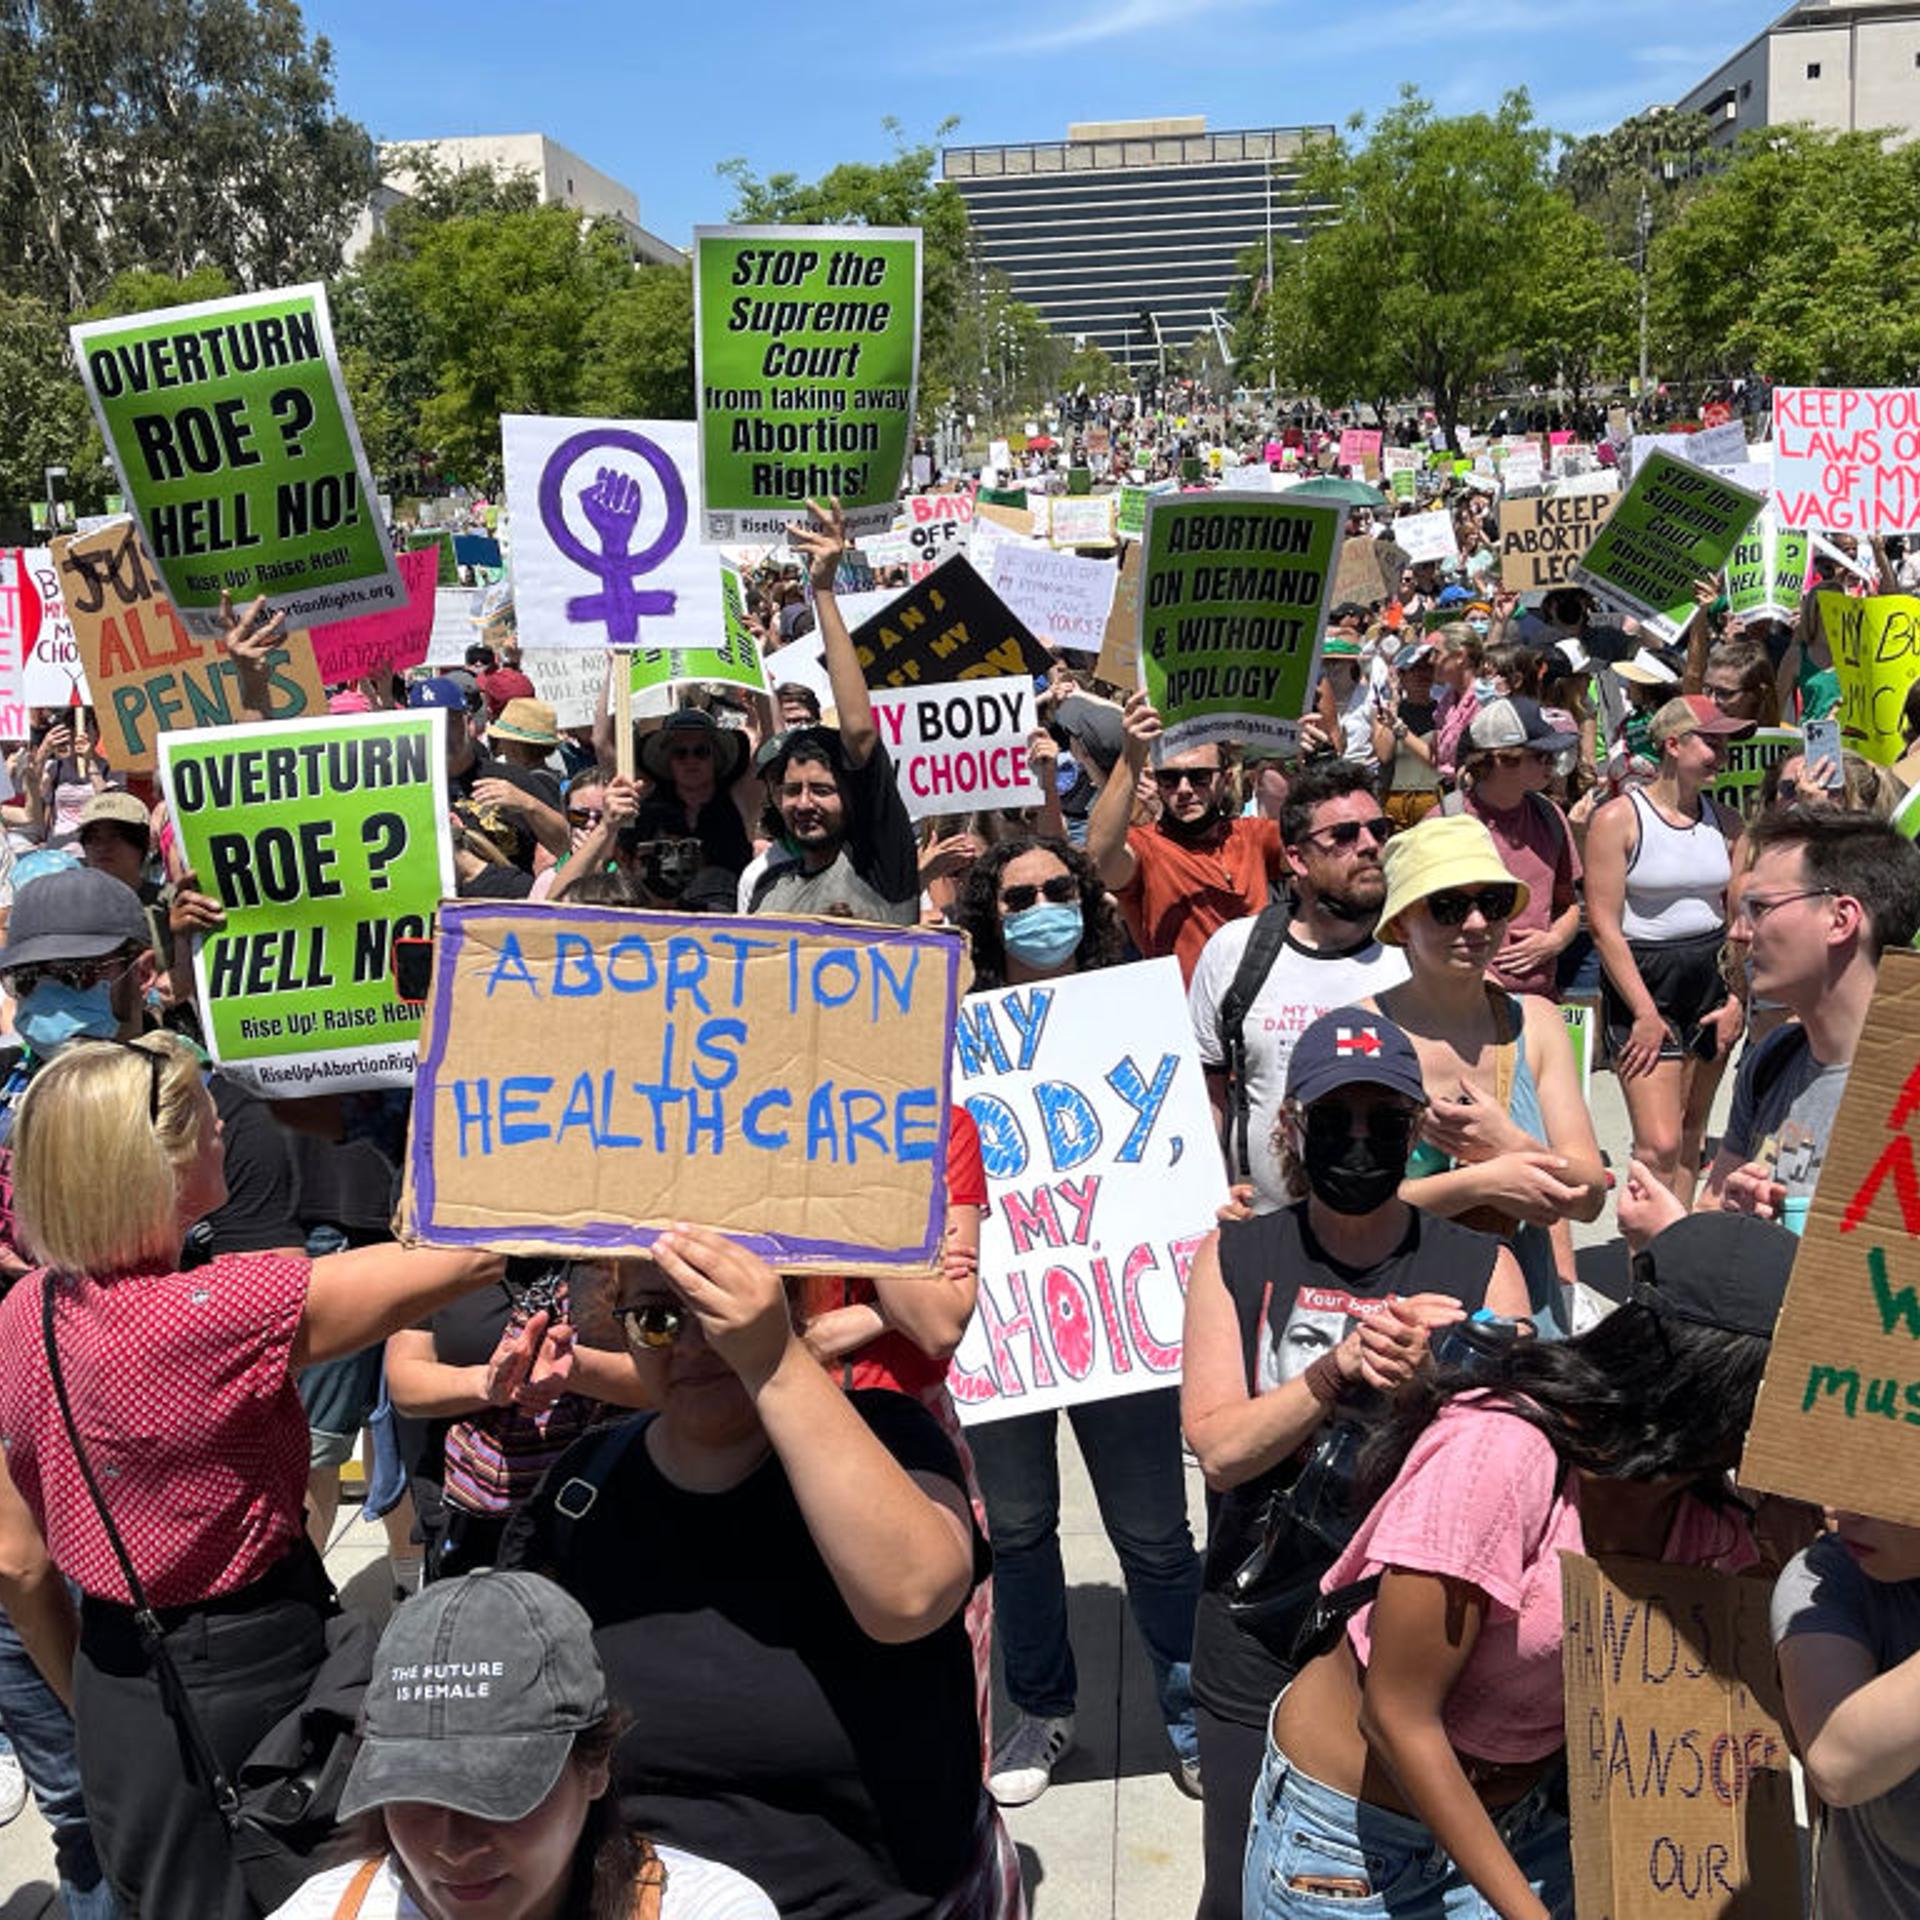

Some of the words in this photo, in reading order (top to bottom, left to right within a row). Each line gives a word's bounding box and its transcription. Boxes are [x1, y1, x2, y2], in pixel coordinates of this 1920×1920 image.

[732, 250, 819, 287] STOP
[827, 251, 887, 287] the
[728, 297, 890, 338] Supreme
[88, 311, 322, 398] OVERTURN
[762, 342, 861, 379] Court
[704, 386, 763, 411] from
[771, 385, 846, 413] taking
[854, 388, 911, 412] away
[1774, 389, 1860, 430] KEEP
[134, 399, 260, 482] ROE
[270, 387, 313, 457] ?
[732, 416, 879, 453] Abortion
[1779, 428, 1882, 464] LAWS
[752, 462, 869, 500] Rights!
[1657, 466, 1706, 493] STOP
[1705, 490, 1740, 513] the
[1823, 464, 1861, 498] OF
[1875, 465, 1920, 498] MY
[151, 492, 261, 559] HELL
[277, 472, 359, 540] NO!
[1536, 494, 1609, 526] KEEP
[1642, 486, 1730, 537] Supreme
[911, 520, 957, 547] OFF
[1168, 514, 1314, 554] ABORTION
[1646, 514, 1703, 549] Court
[255, 560, 307, 584] Raise
[310, 547, 351, 574] Hell!
[1605, 560, 1674, 606] Rights!
[1608, 537, 1690, 589] Abortion
[1150, 570, 1184, 608] ON
[1192, 567, 1320, 606] DEMAND
[1153, 627, 1168, 660] &
[1178, 616, 1304, 656] WITHOUT
[1167, 664, 1280, 710] APOLOGY
[917, 692, 1024, 743] BODY
[172, 734, 429, 813] OVERTURN
[909, 746, 1031, 798] CHOICE
[209, 820, 342, 909] ROE
[362, 812, 406, 892] ?
[210, 926, 333, 999] HELL
[475, 932, 920, 1022] ABORTION
[241, 1017, 283, 1039] Rise
[287, 1011, 318, 1036] Up!
[324, 1006, 377, 1031] Raise
[1282, 1004, 1307, 1018] MY
[660, 1017, 748, 1092] IS
[953, 987, 1055, 1081] MY
[963, 1053, 1185, 1181] ODY,
[1303, 1288, 1344, 1306] Your
[946, 1234, 1205, 1405] HOIC
[391, 1664, 419, 1681] THE
[422, 1661, 504, 1679] FUTURE
[396, 1686, 412, 1701] IS
[414, 1682, 490, 1700] FEMALE
[1649, 1837, 1737, 1901] OUR
